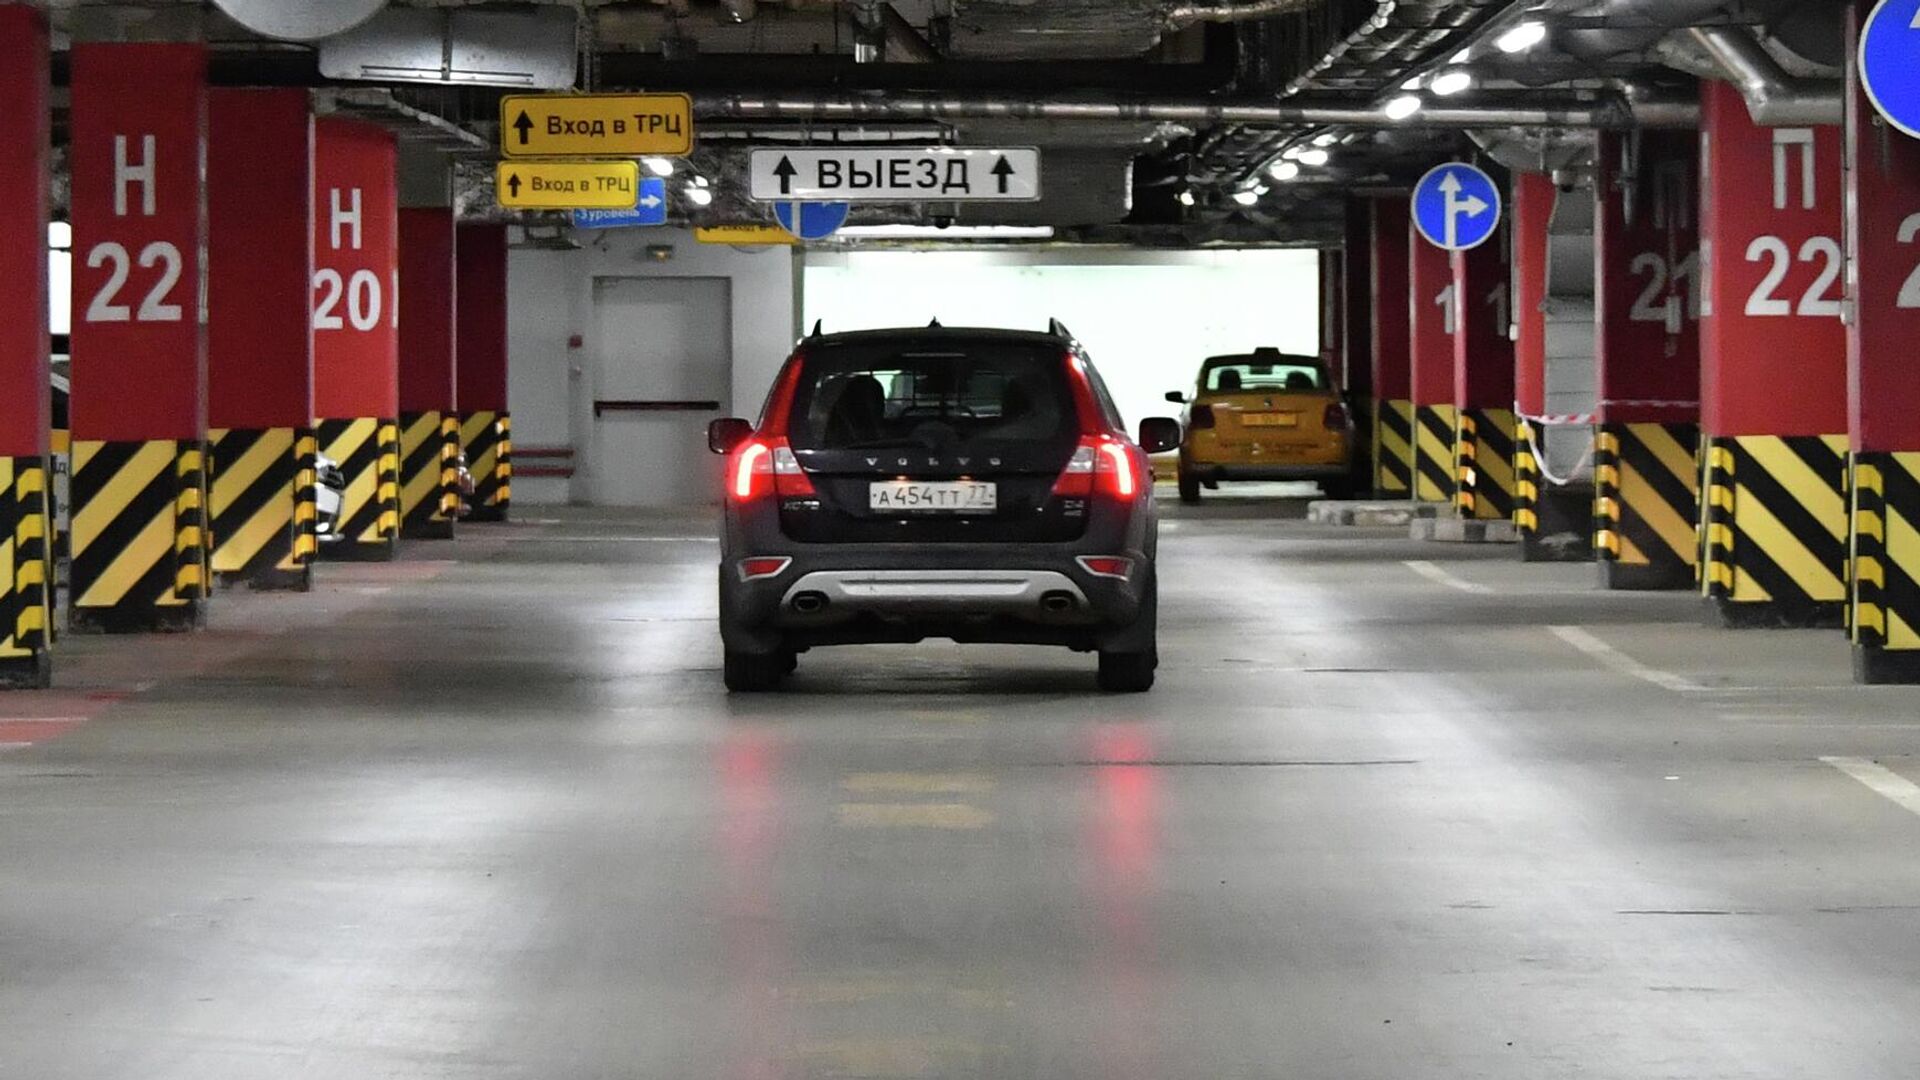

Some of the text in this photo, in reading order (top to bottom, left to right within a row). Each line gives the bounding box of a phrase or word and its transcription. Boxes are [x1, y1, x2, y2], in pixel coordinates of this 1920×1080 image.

[547, 114, 682, 138] Вход в ТРЦ
[115, 134, 156, 216] Н
[531, 176, 631, 193] Вход в ТРЦ
[817, 158, 971, 195] ВЫЕЗД
[1772, 128, 1815, 210] П
[330, 187, 362, 250] Н
[86, 240, 183, 322] 22
[313, 268, 382, 332] 20
[1745, 235, 1842, 317] 22
[865, 457, 1001, 467] VOLVO
